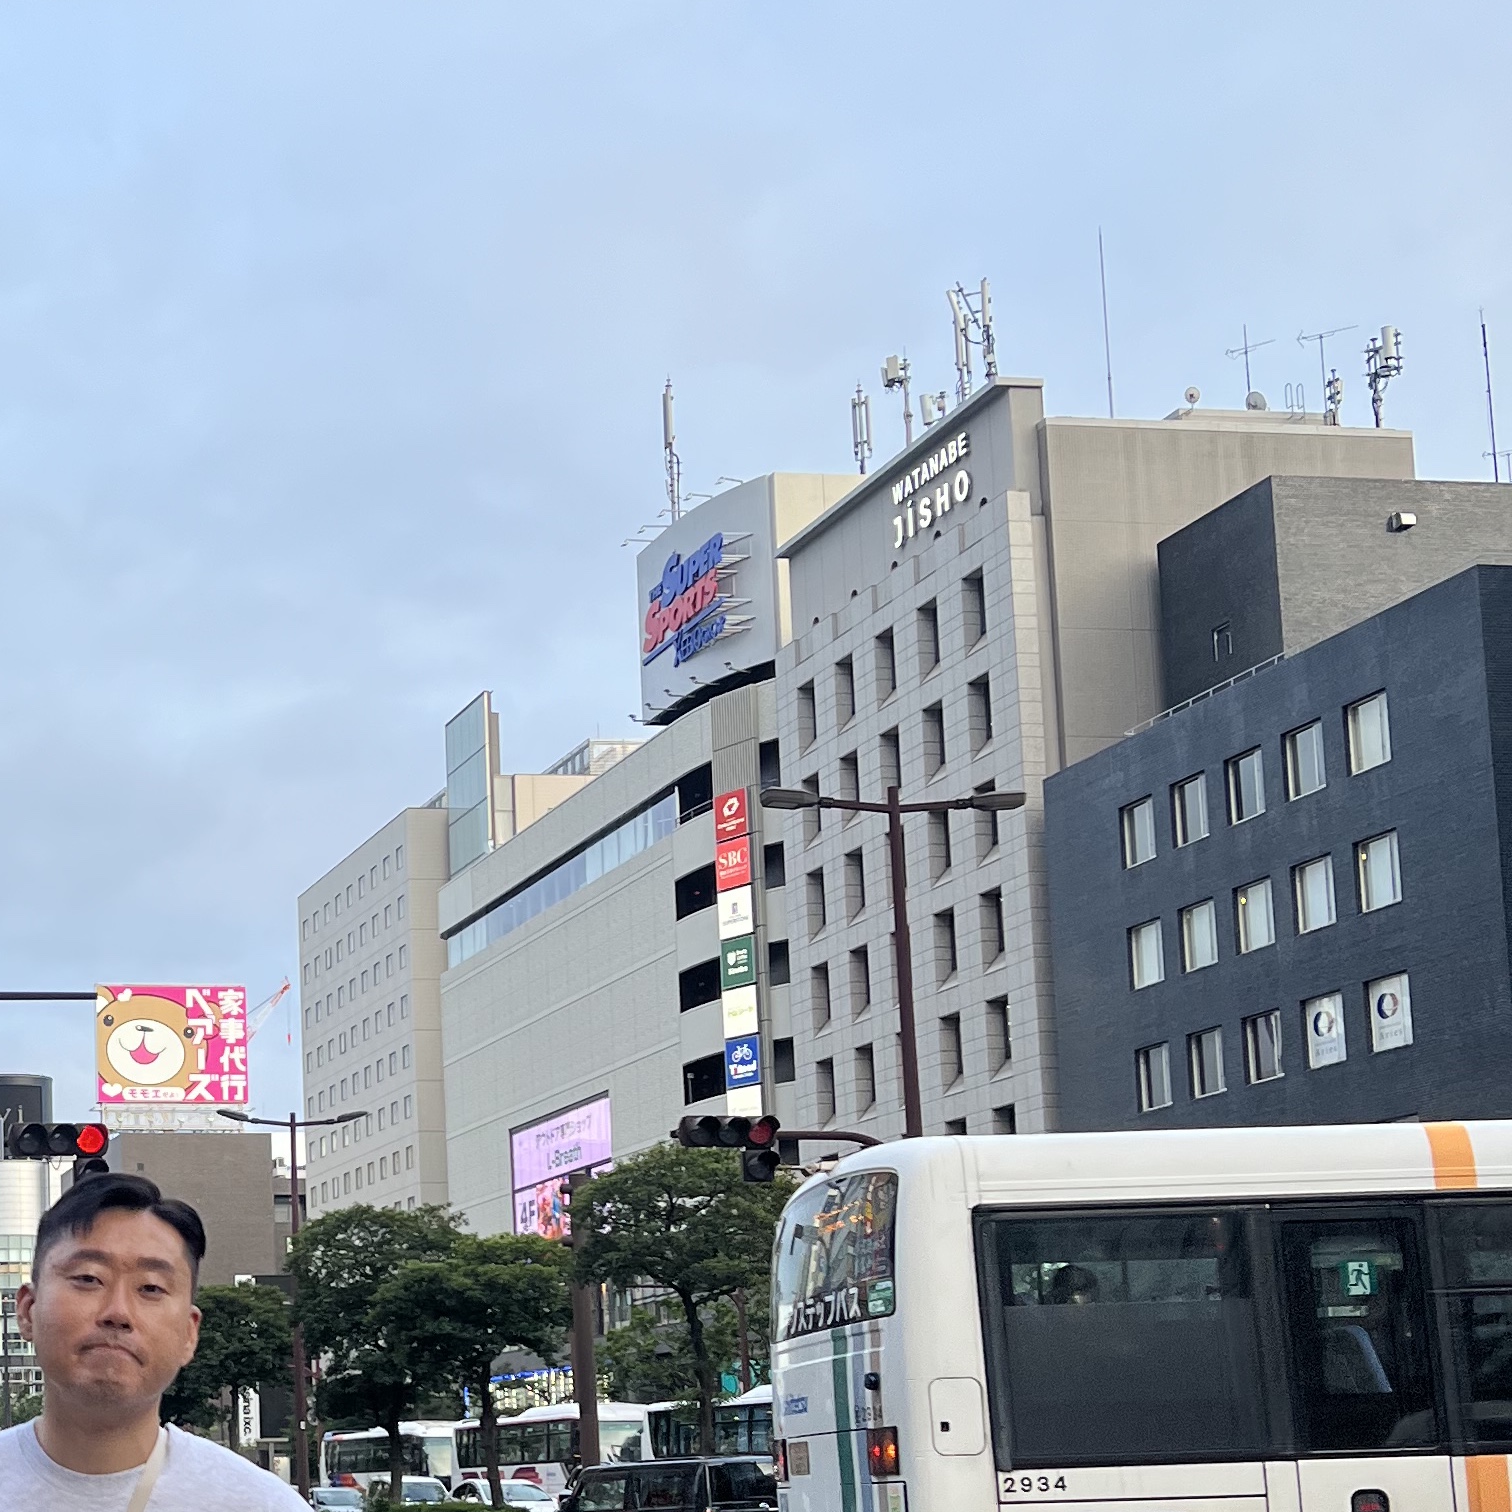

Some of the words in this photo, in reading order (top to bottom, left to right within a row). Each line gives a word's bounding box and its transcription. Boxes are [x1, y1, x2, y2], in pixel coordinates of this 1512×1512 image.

[892, 432, 968, 505] WATANABE
[660, 532, 723, 608] SUPER
[643, 567, 718, 653] SPORTS
[718, 847, 748, 870] SBC
[185, 989, 219, 1100] ベアーズ
[217, 989, 246, 1100] 家事代行
[1003, 1476, 1067, 1492] 2934
